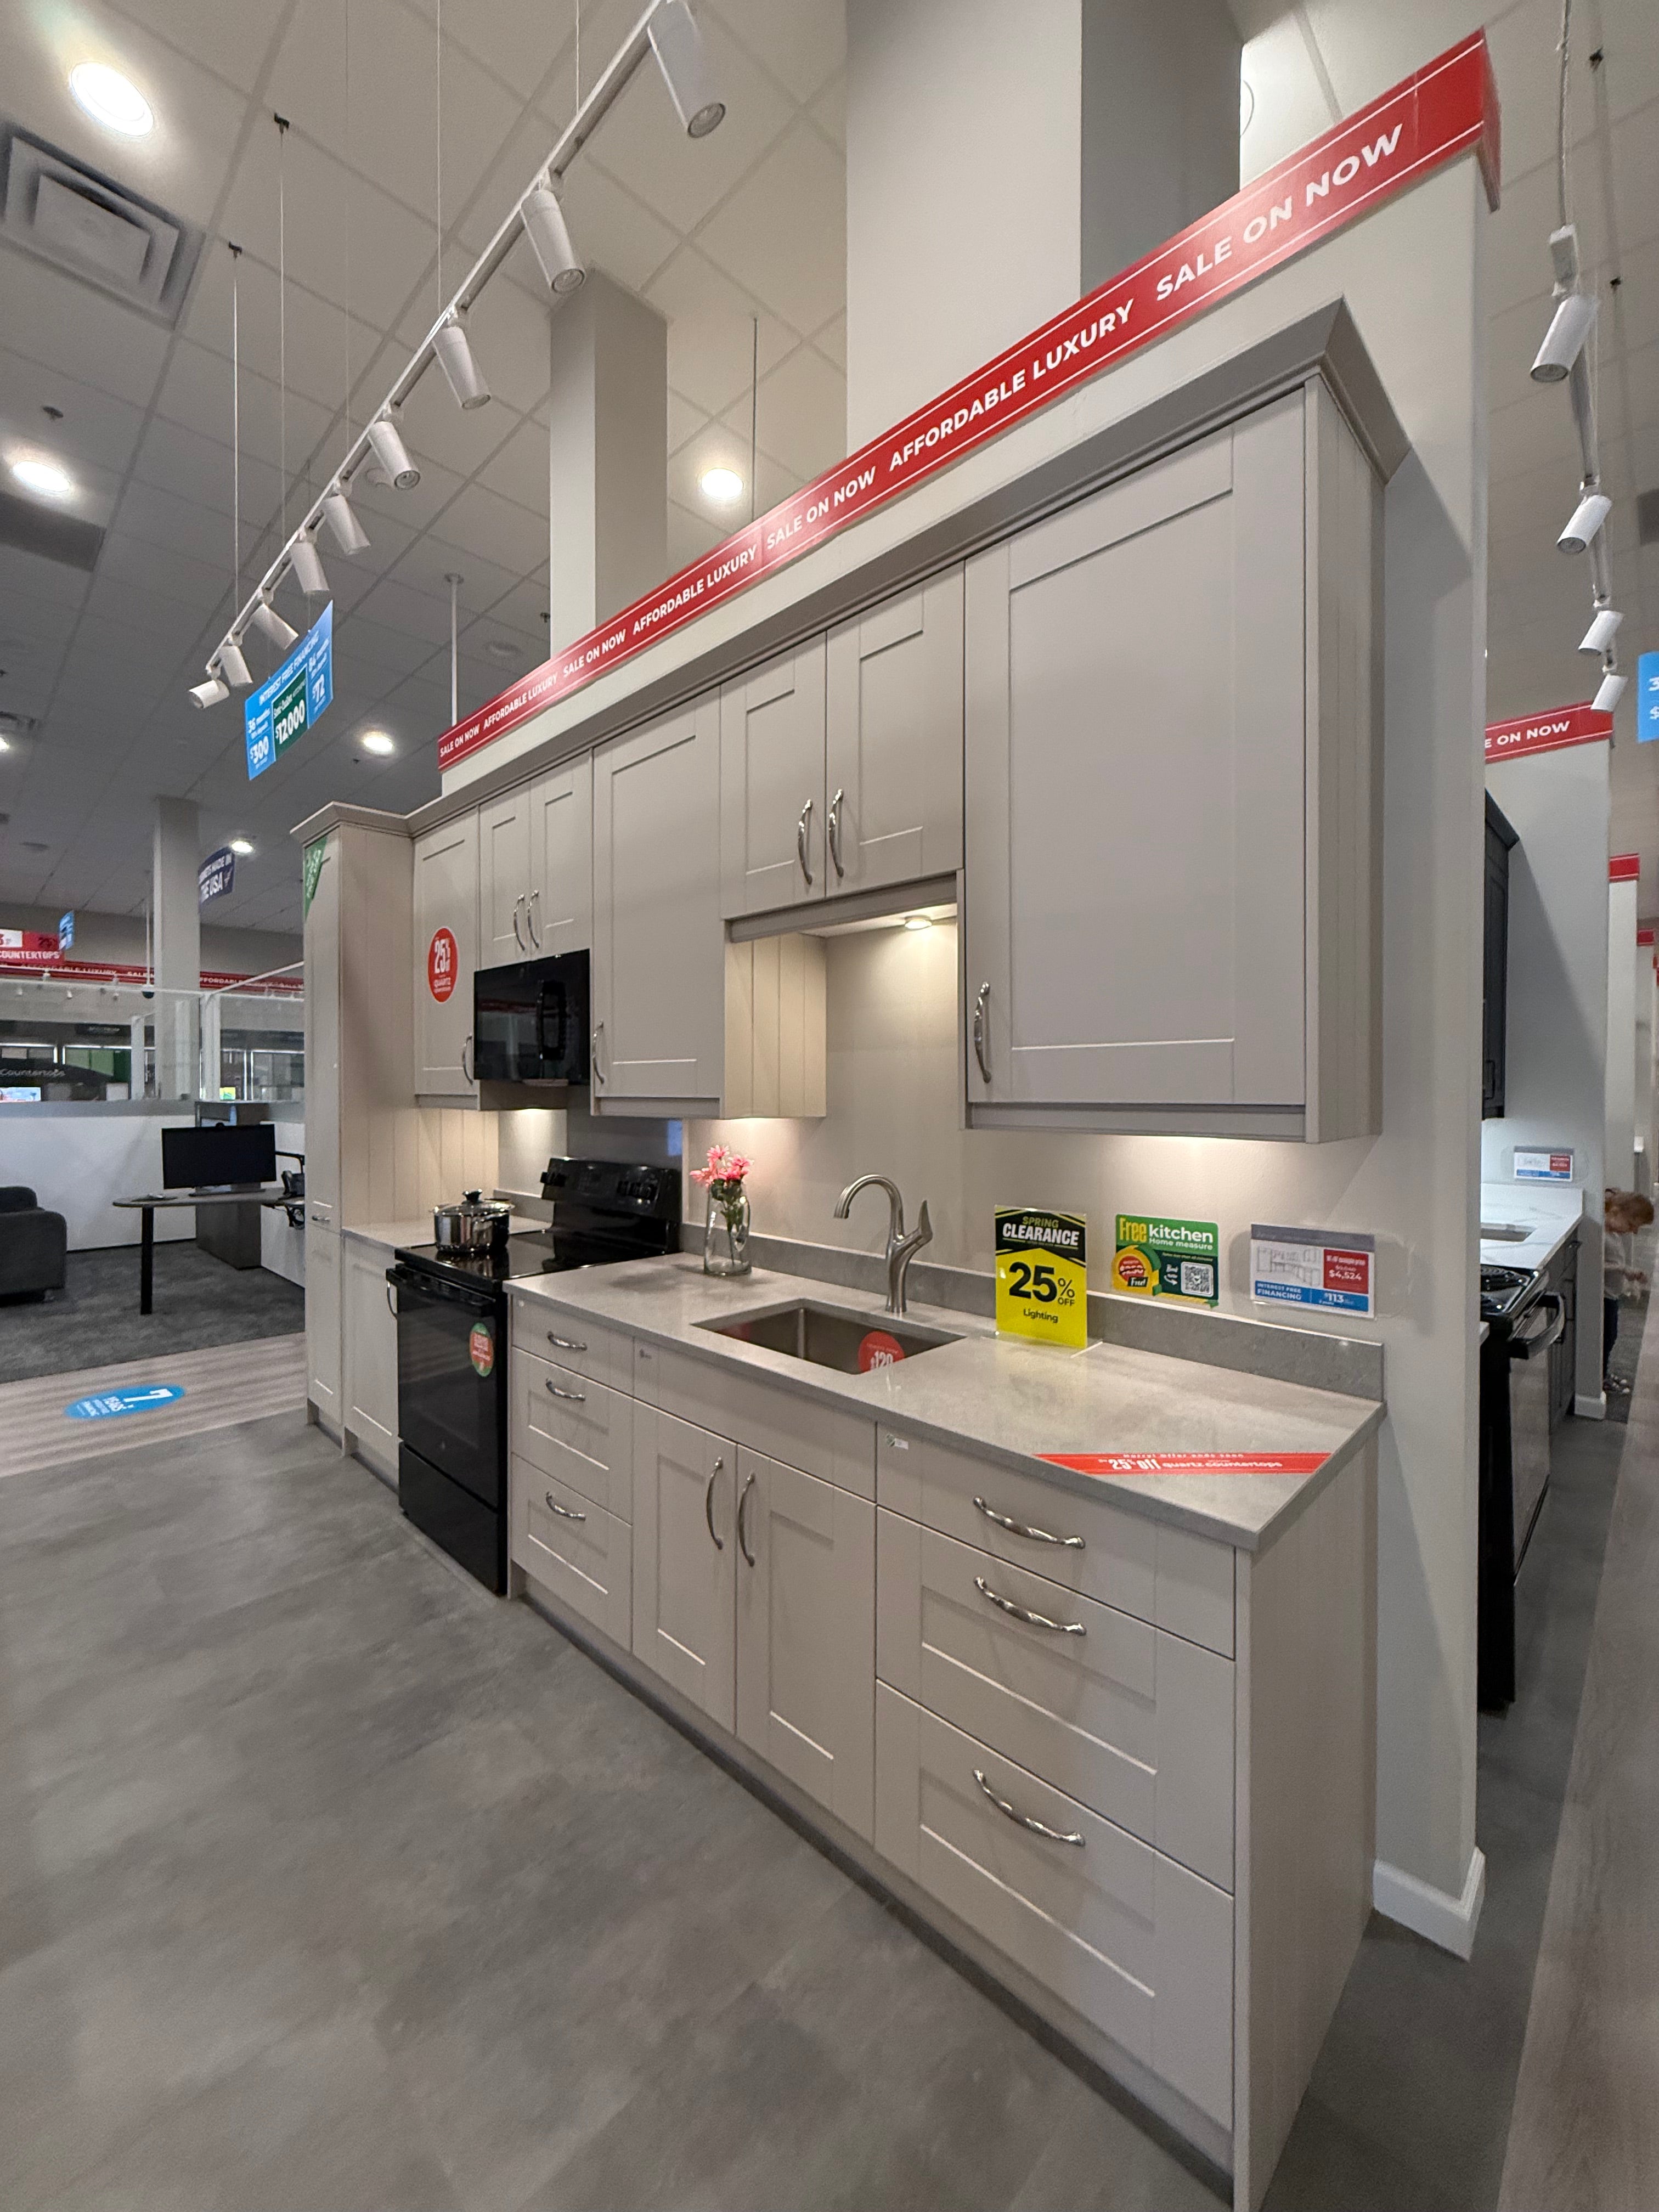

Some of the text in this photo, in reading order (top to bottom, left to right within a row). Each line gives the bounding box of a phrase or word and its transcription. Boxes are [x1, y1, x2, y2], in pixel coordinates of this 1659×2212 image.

[440, 123, 1403, 758] SALE ON NOW AFFORDABLE LUXURY SALE ON NOW AFFORDABLE LUXURY SALE ON NOW AFFORDABLE LUXURY SALE ON NOW
[1497, 732, 1521, 746] ON
[1526, 720, 1571, 740] NOW
[1022, 1216, 1059, 1228] SPRING
[1002, 1223, 1080, 1246] CLEARANCE
[1120, 1217, 1214, 1244] Free kitchen
[1149, 1238, 1214, 1251] Home measure
[1329, 1269, 1362, 1281] $4,524
[1058, 1297, 1075, 1307] OFF
[1257, 1289, 1302, 1301] FINANCING
[1023, 1308, 1058, 1323] Lighting
